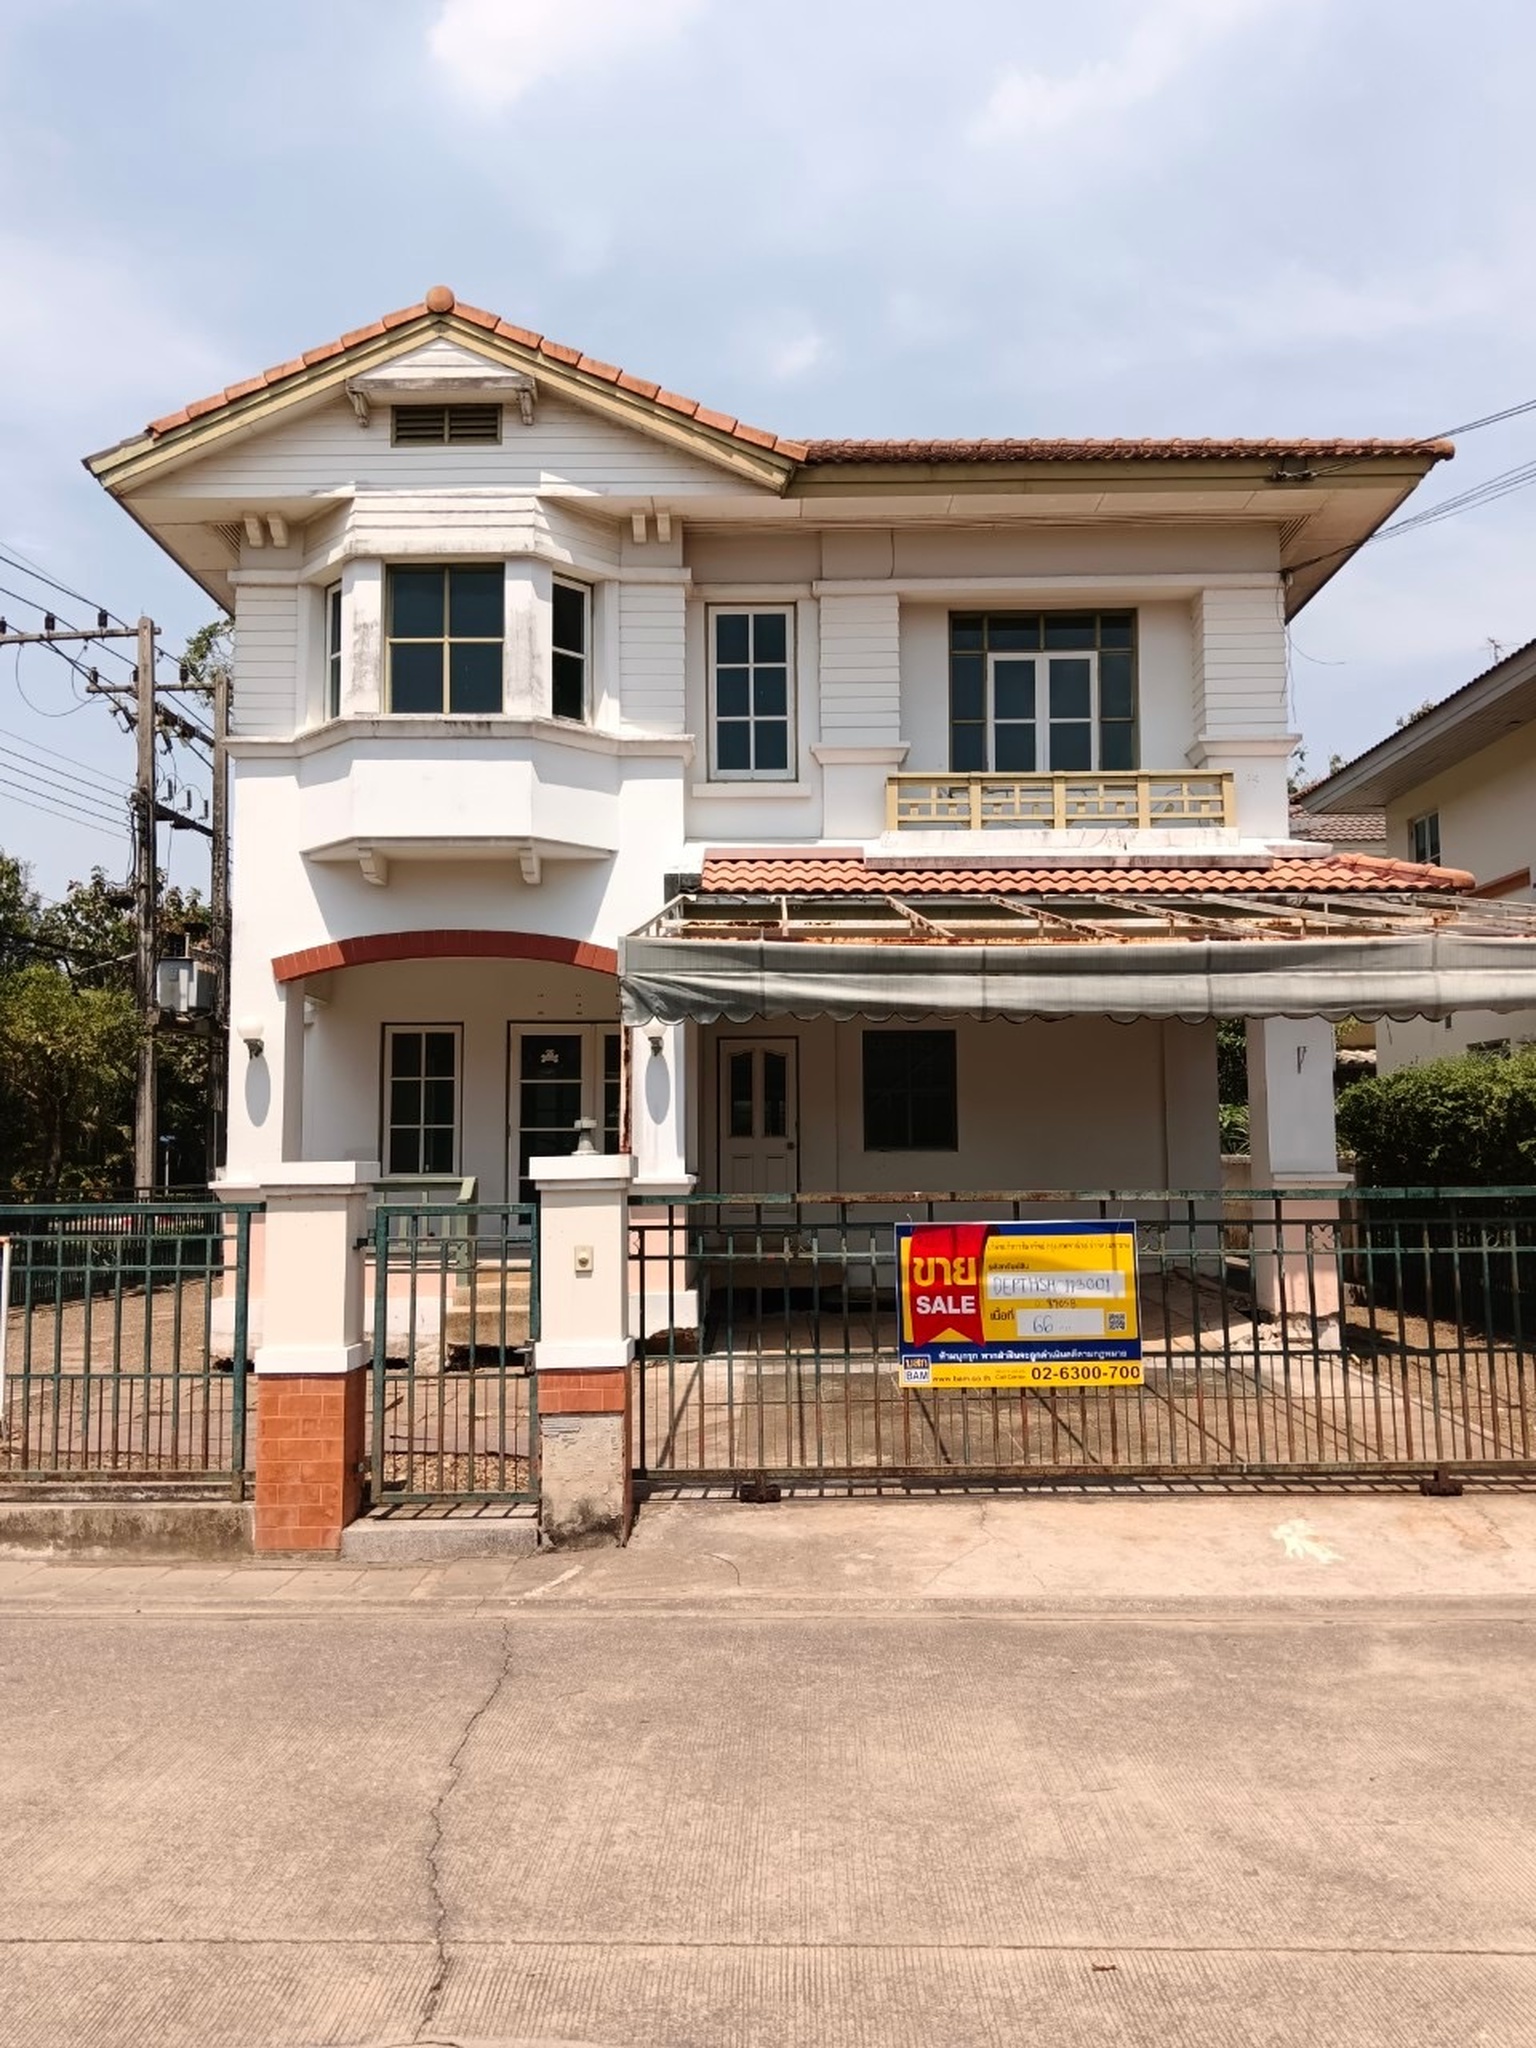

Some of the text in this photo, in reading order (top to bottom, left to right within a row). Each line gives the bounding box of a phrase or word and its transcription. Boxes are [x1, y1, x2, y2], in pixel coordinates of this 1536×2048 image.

[913, 1257, 977, 1287] ขาย
[916, 1295, 977, 1315] SALE
[906, 1370, 929, 1381] BAM
[1031, 1365, 1140, 1380] 02-6300-700
